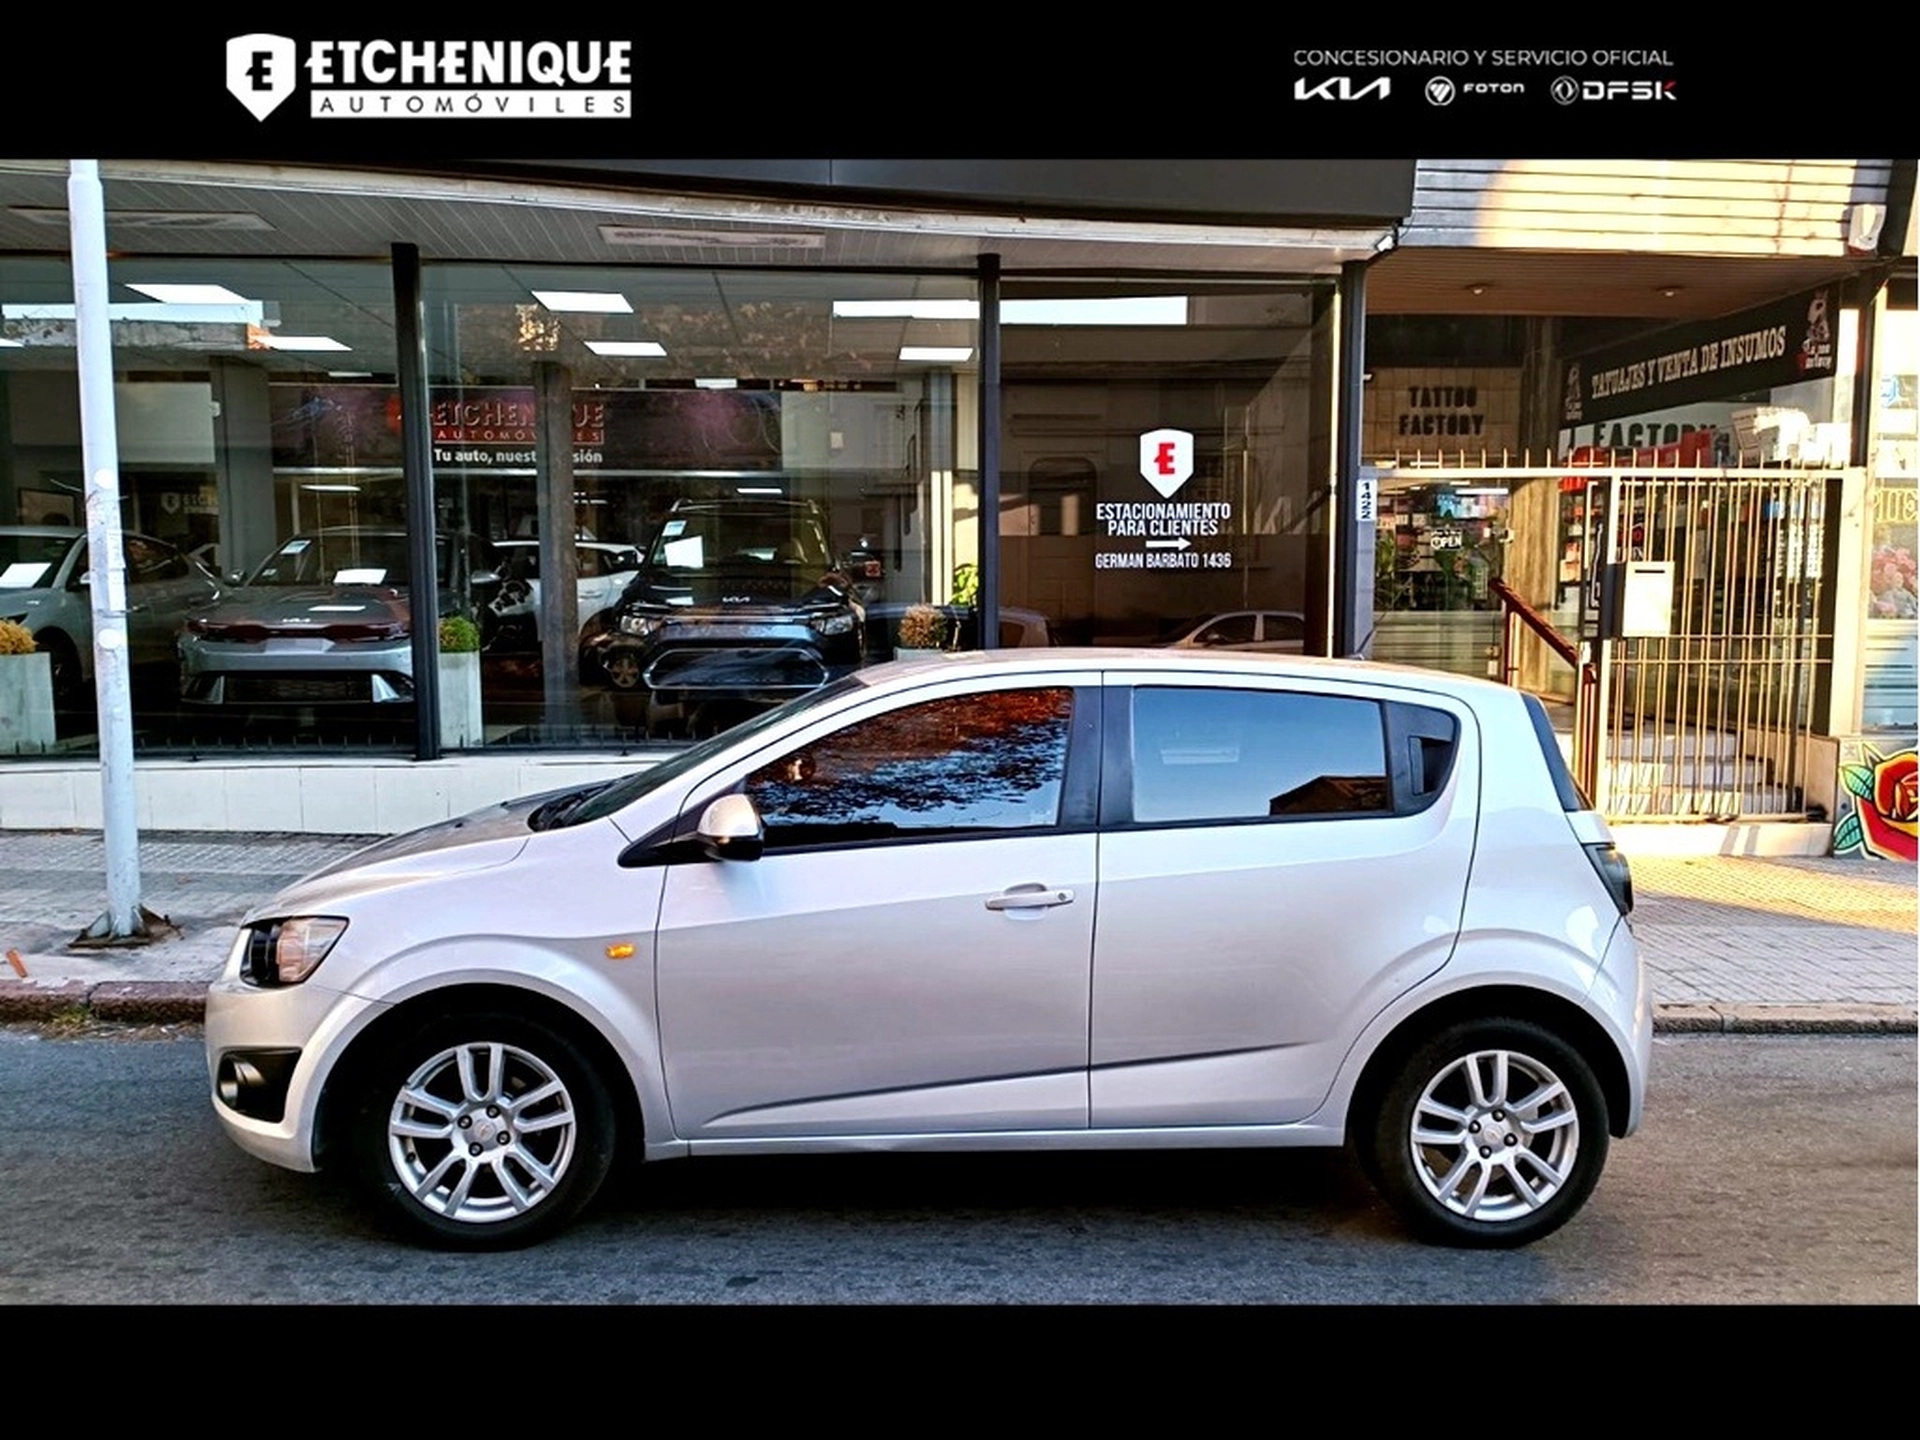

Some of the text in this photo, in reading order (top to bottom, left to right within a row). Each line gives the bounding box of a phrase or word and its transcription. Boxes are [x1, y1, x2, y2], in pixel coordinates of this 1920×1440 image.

[1592, 366, 1645, 399] TATUAJES
[1646, 358, 1655, 386] Y
[1657, 348, 1698, 382] VENTA
[1700, 343, 1718, 374] DE
[1720, 325, 1787, 369] INSUMOS
[1408, 386, 1477, 408] TATTOO
[1399, 413, 1484, 436] FACTORY
[433, 449, 451, 463] Tu
[455, 449, 492, 464] auto,
[1096, 503, 1231, 520] ESTACIONAMIENTO
[1107, 520, 1219, 536] PARA CLIENTES
[1095, 553, 1232, 568] GERMAN BARBATO 1436
